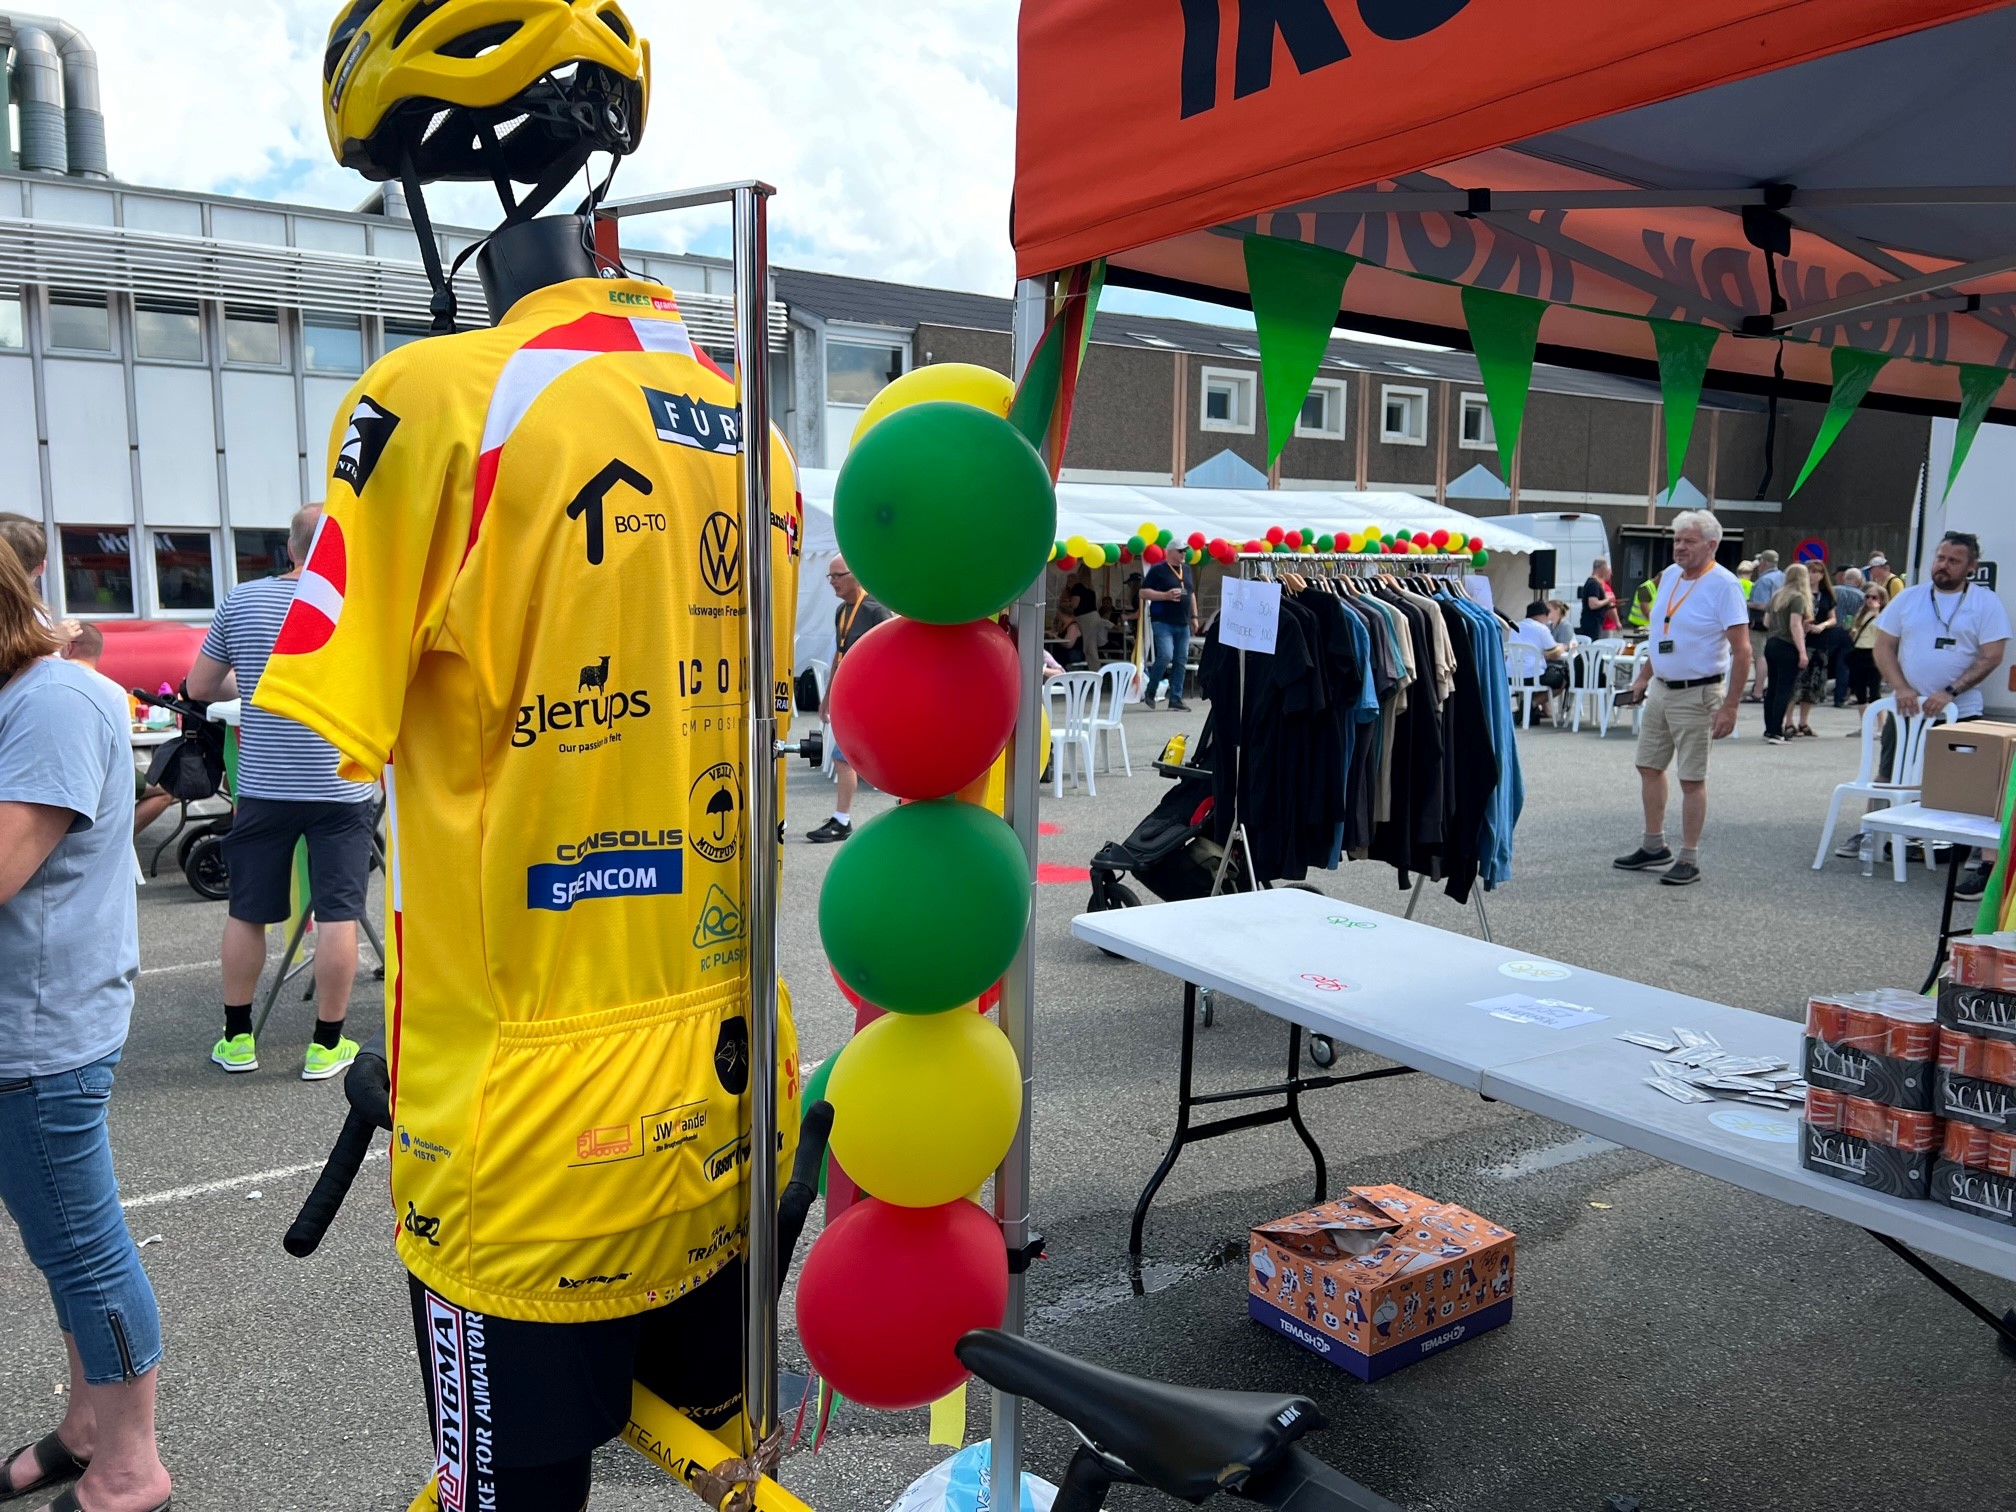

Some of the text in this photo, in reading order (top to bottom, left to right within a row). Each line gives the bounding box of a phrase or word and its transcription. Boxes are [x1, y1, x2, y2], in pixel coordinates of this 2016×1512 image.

[609, 290, 650, 306] ECKES
[615, 513, 666, 533] BO-TO
[679, 658, 741, 697] ICO
[511, 689, 651, 748] glerups
[559, 743, 576, 753] Our
[609, 732, 621, 742] felt
[701, 949, 739, 973] RC PLAS
[1812, 1047, 1870, 1082] SCAVI
[1946, 1082, 2007, 1119] SCAVI
[413, 1136, 452, 1159] MobilePay
[413, 1148, 436, 1162] 41576
[1811, 1135, 1868, 1170] SCAVI
[1950, 1173, 2015, 1212] SCAVI
[1279, 1318, 1331, 1353] TEMASHOP
[1420, 1325, 1466, 1353] TEMASHOP
[433, 1317, 460, 1465] BYGMA
[1277, 1405, 1301, 1428] MBK
[475, 1427, 494, 1476] FOR
